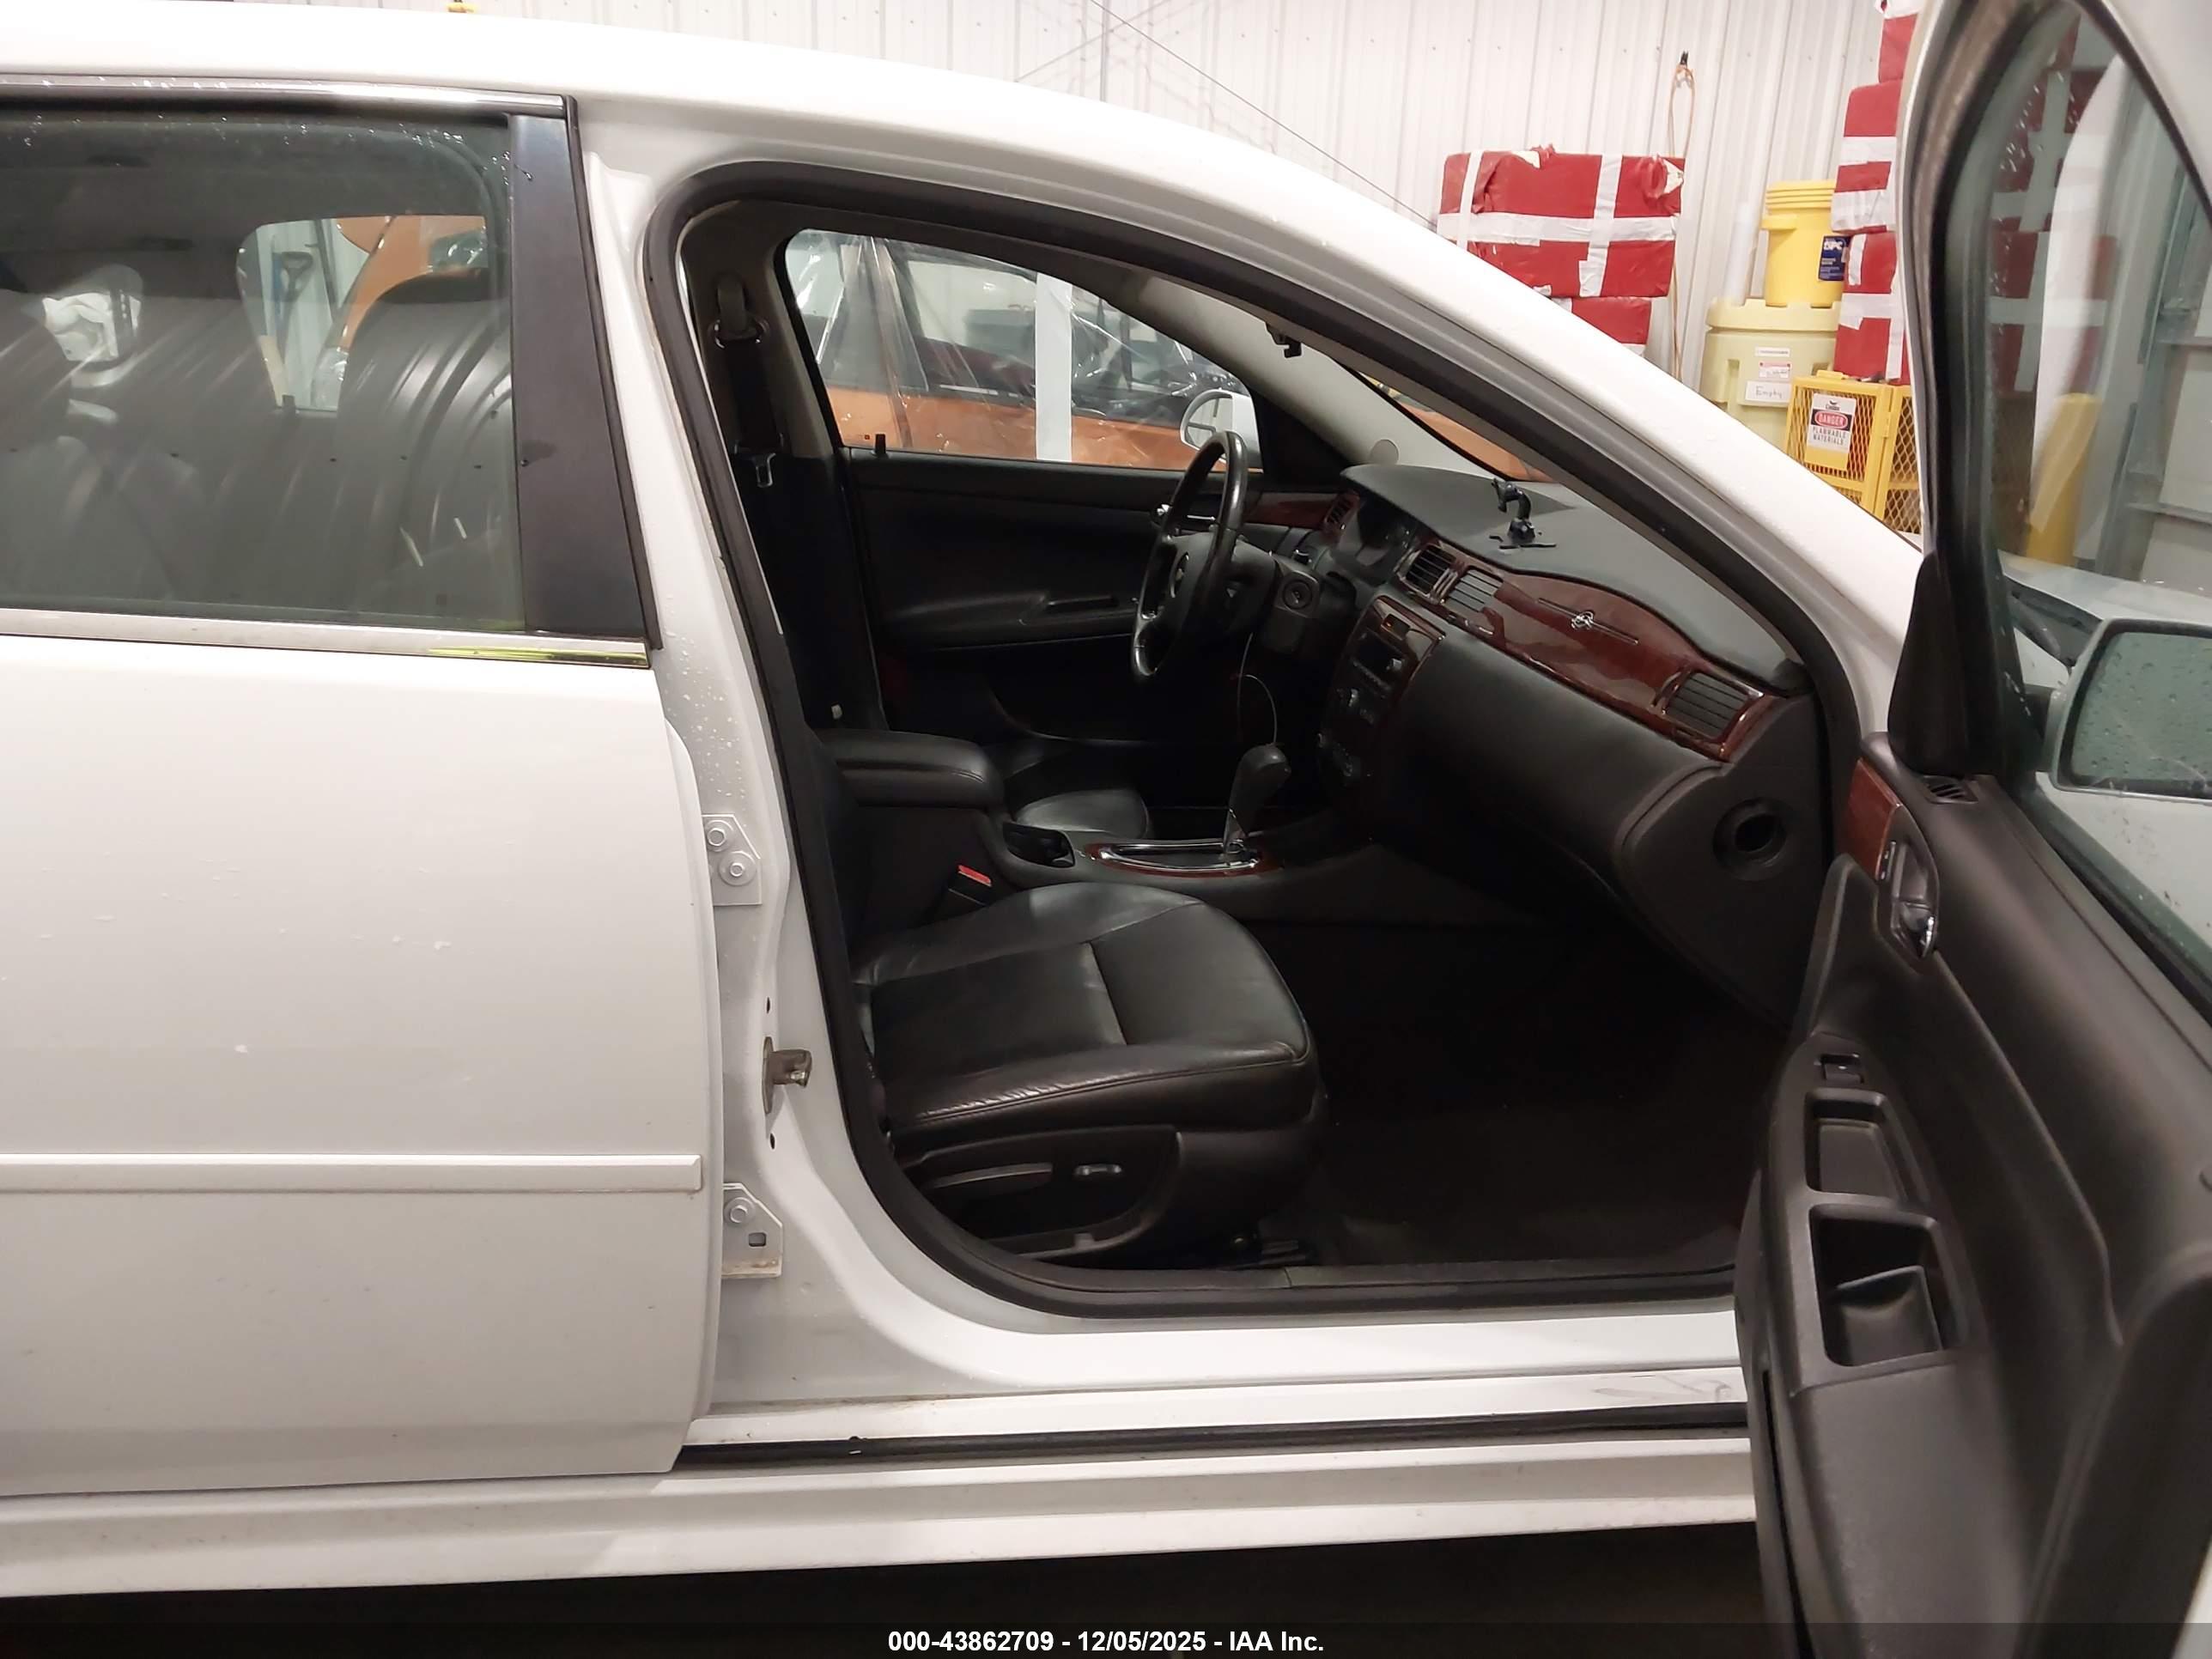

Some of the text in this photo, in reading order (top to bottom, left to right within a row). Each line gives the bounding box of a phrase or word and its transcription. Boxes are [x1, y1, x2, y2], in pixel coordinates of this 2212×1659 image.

[1818, 413, 1845, 427] DANGER
[1813, 427, 1846, 438] FLAMMABLE
[1813, 434, 1844, 445] MATERIALS
